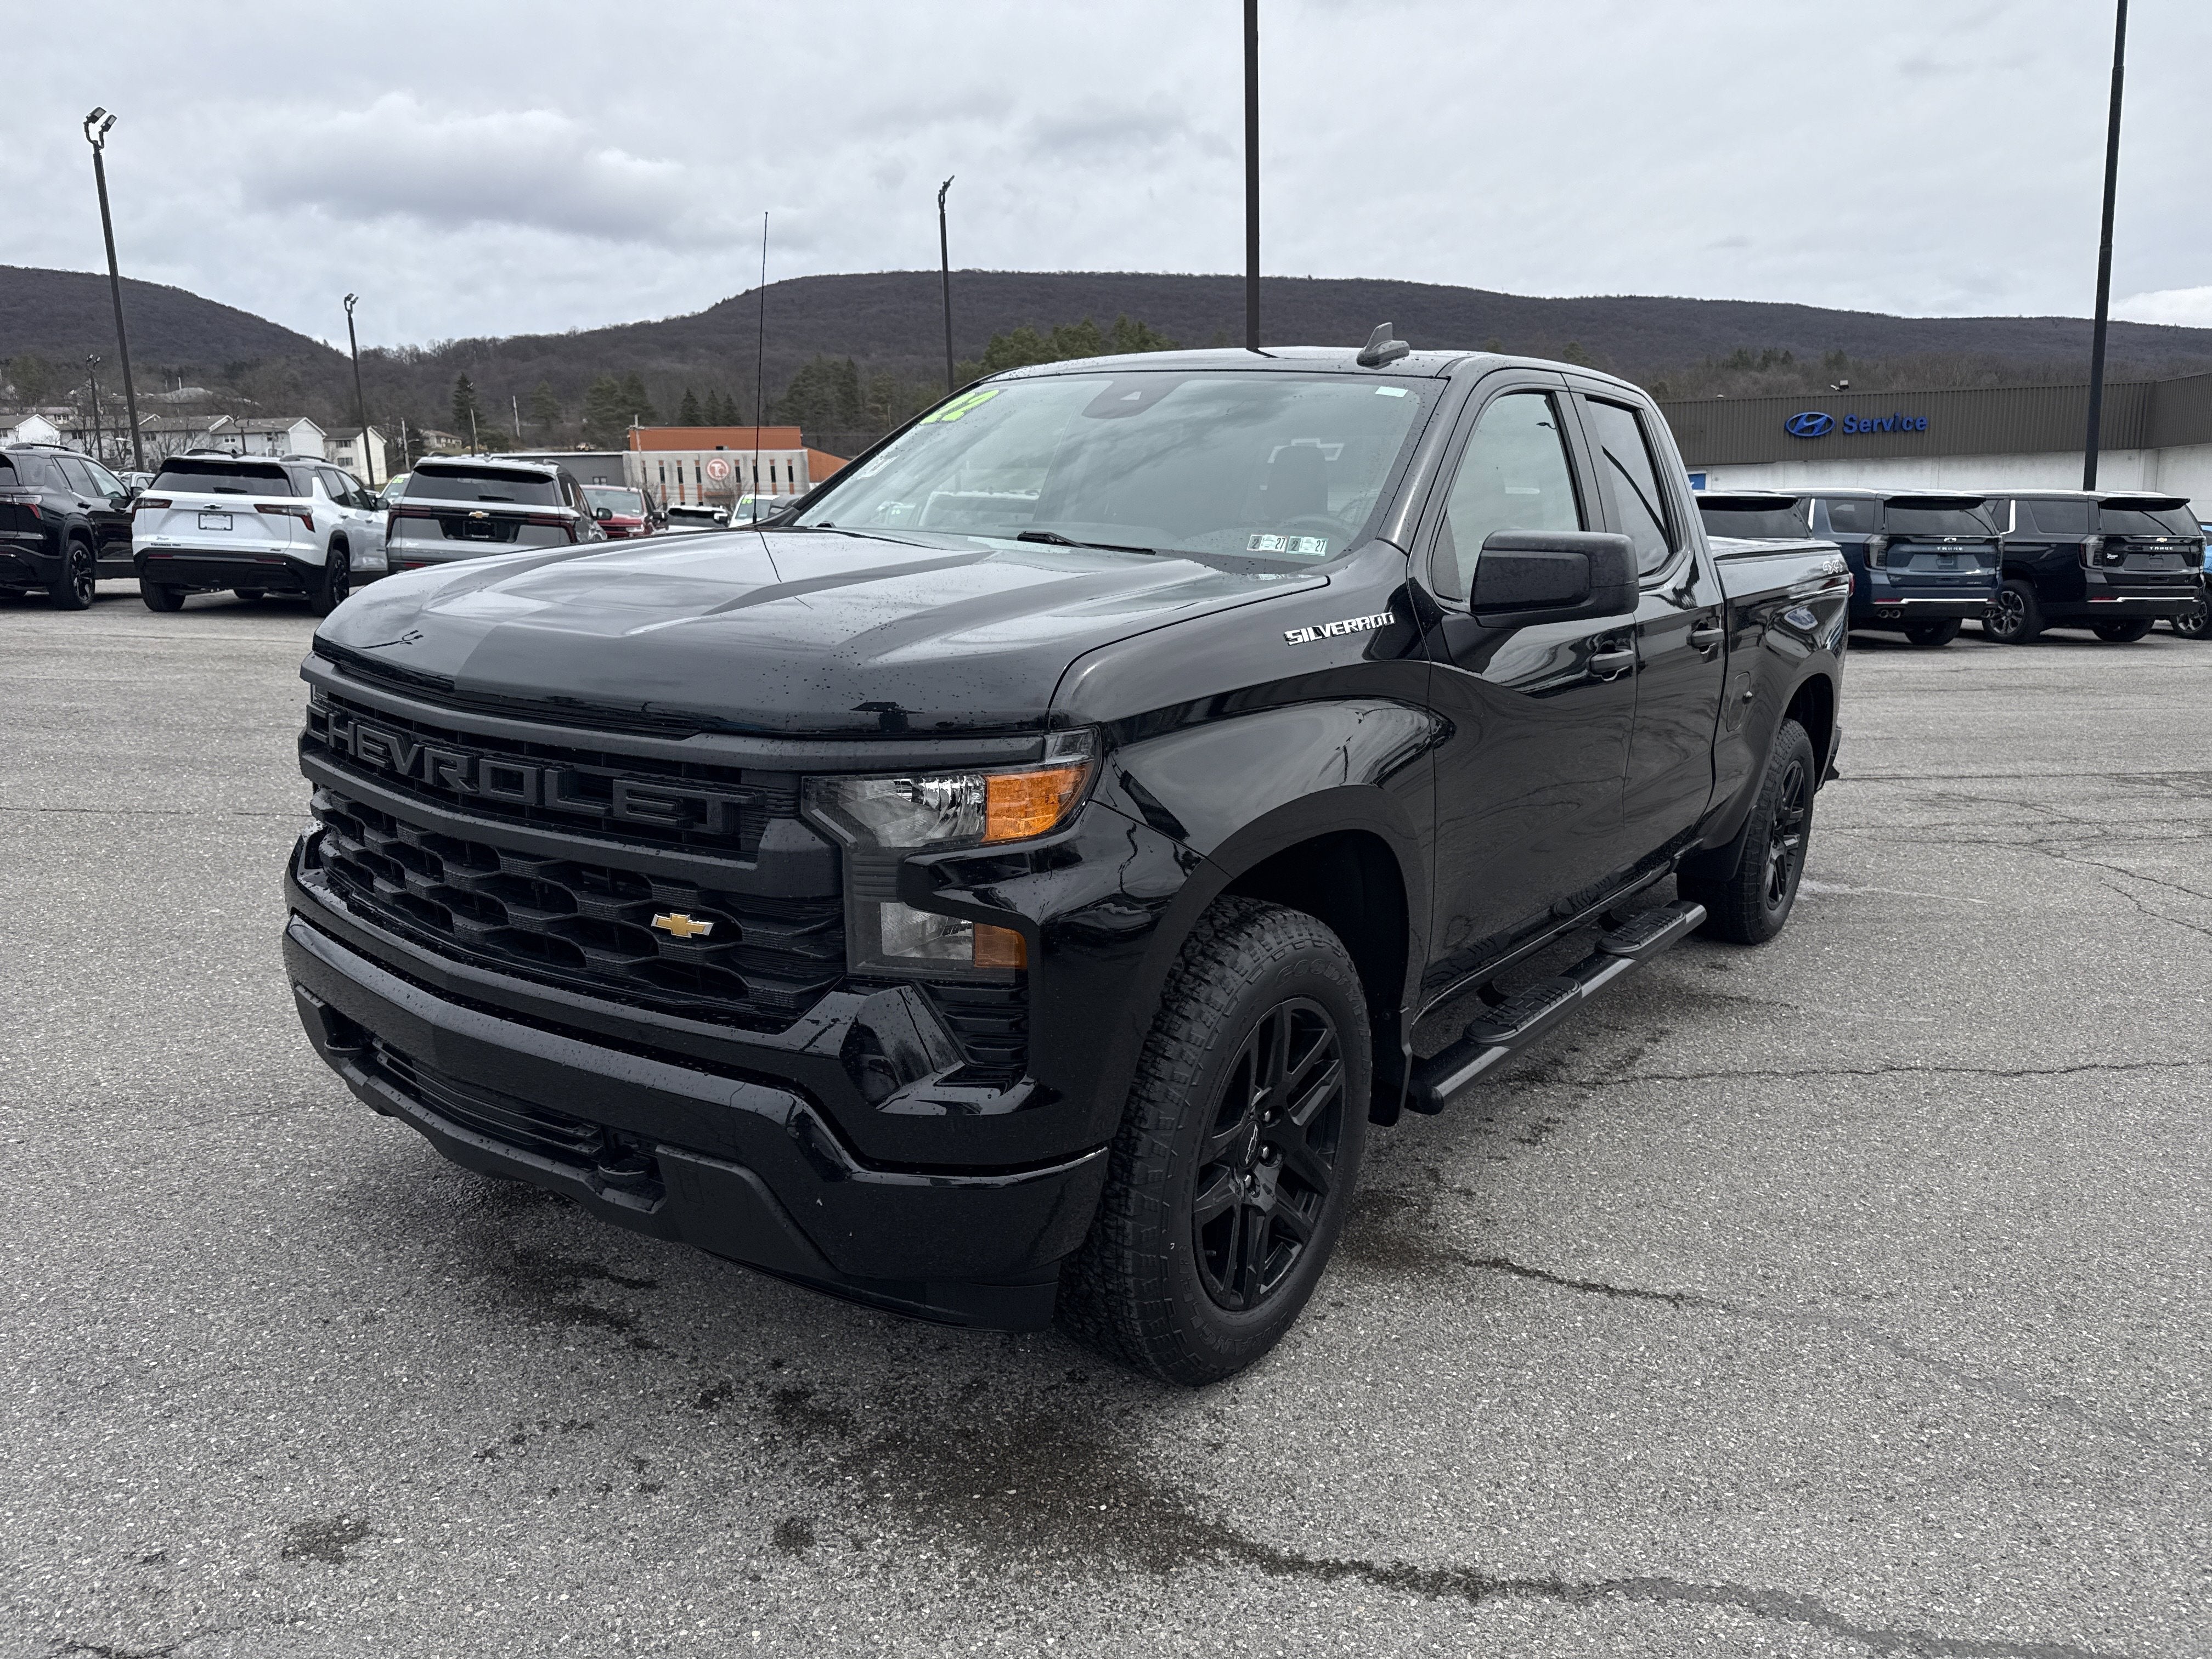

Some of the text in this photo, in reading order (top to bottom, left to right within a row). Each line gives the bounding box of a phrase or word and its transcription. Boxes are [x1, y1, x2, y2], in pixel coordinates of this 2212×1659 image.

[1843, 413, 1928, 434] Service
[1275, 537, 1286, 550] 27
[1291, 539, 1325, 552] 2 27
[1283, 612, 1396, 646] SILVERADO
[306, 702, 765, 834] CHEVROLET
